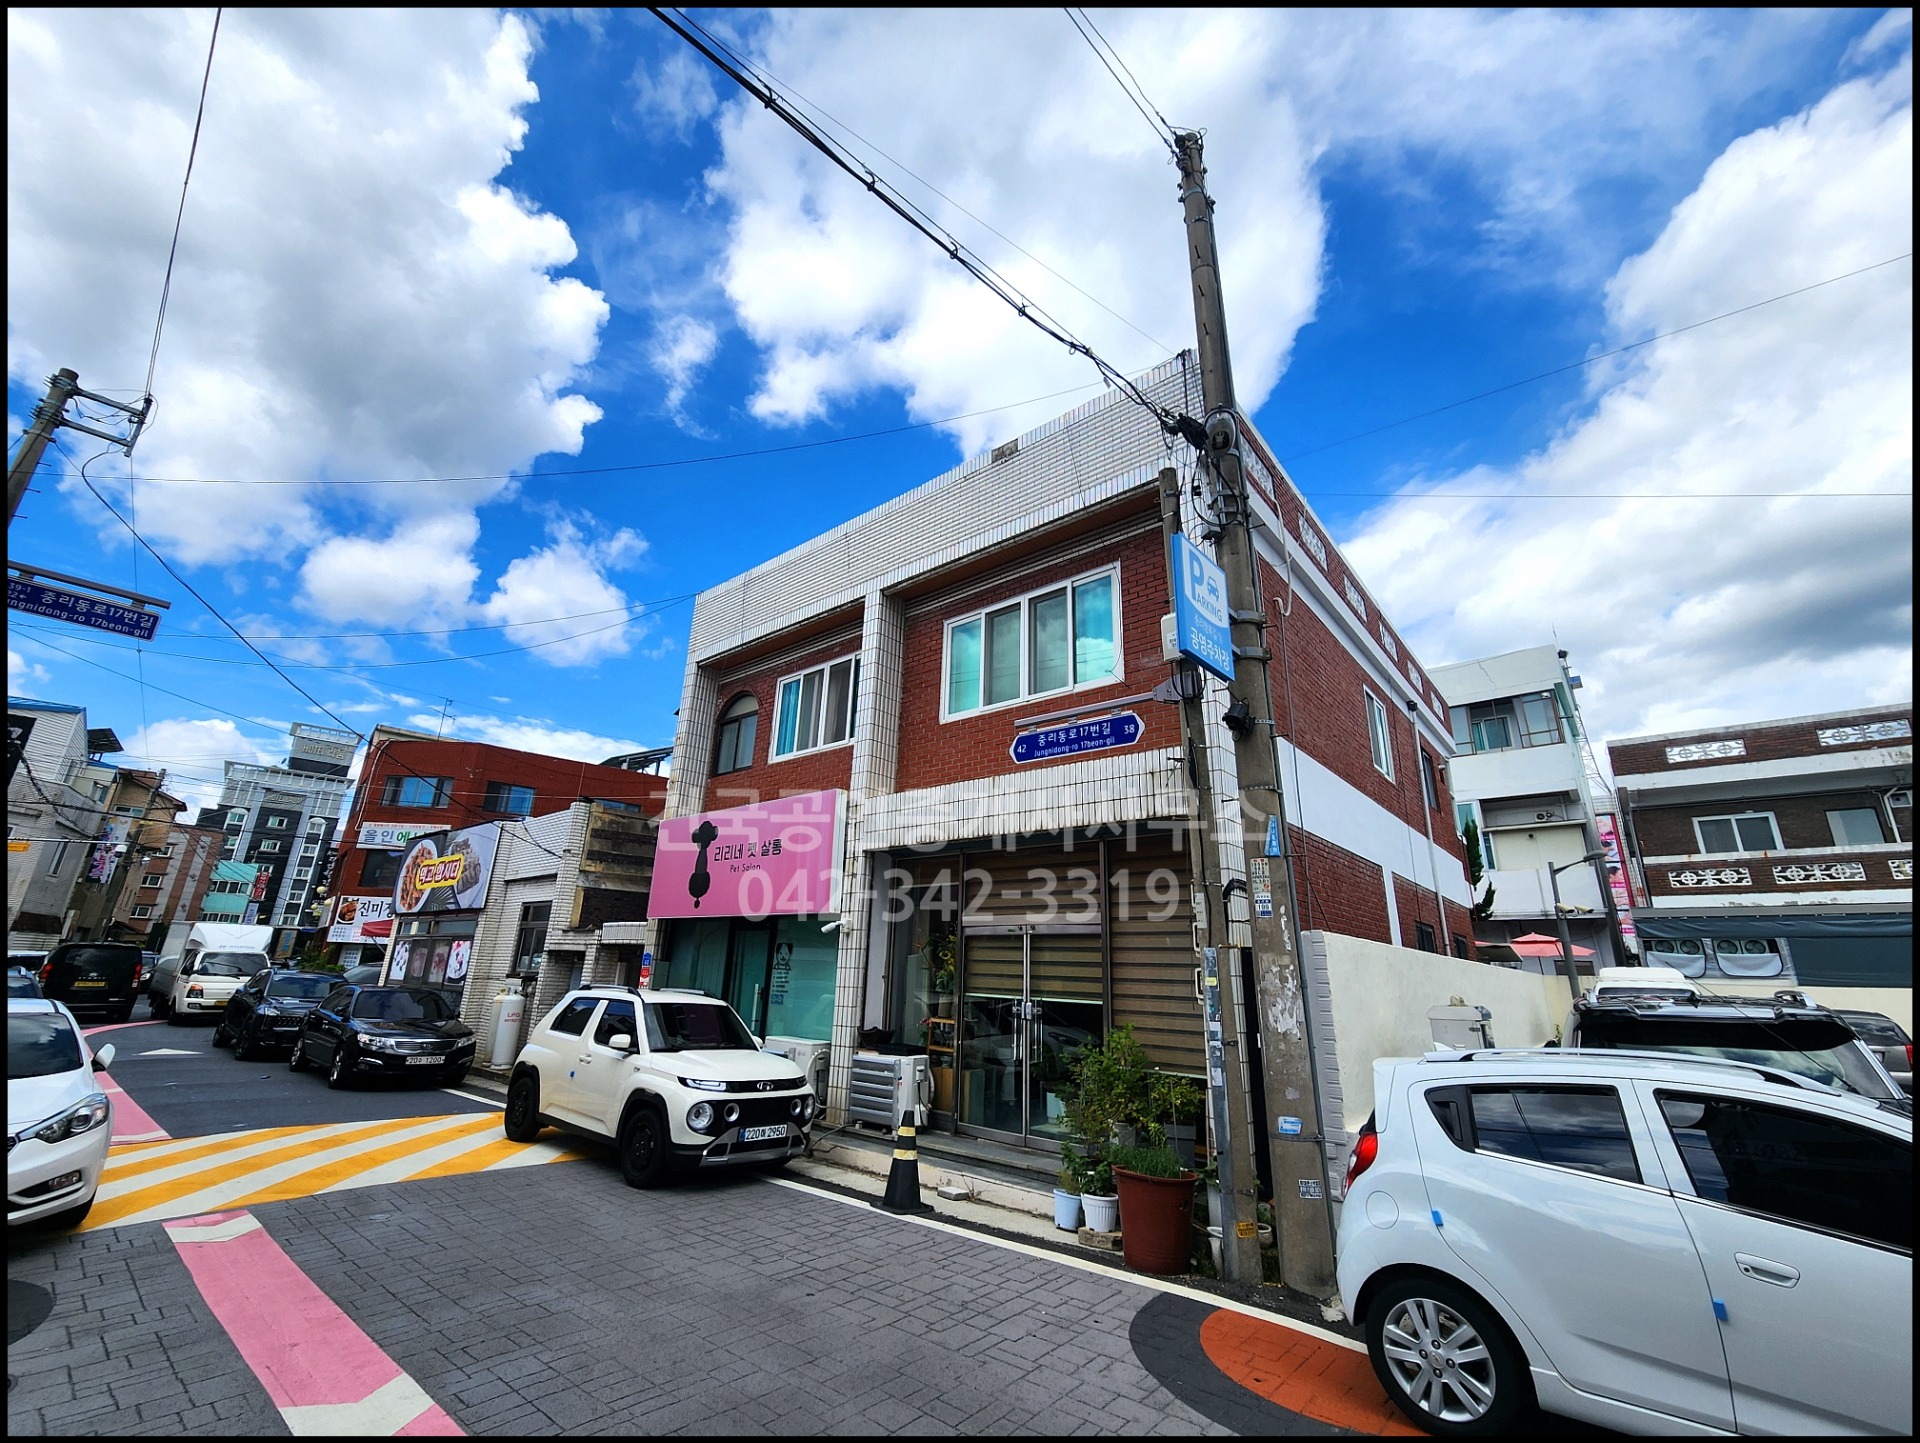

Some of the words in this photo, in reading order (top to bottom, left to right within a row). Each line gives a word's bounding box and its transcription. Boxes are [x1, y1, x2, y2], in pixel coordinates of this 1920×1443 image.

[41, 590, 154, 629] 중리동로17번길
[90, 617, 149, 637] 17beon-gil
[1190, 626, 1230, 671] 공영주차장
[1037, 722, 1111, 747] 중리동로17번길
[1123, 724, 1135, 735] 38
[302, 743, 324, 756] HOTEL
[1017, 744, 1027, 753] 42
[714, 843, 744, 861] 리리네
[747, 842, 758, 858] 펫
[761, 838, 782, 857] 살롱
[729, 864, 740, 873] Pet
[741, 862, 761, 873] Salon
[767, 1126, 786, 1137] 2950
